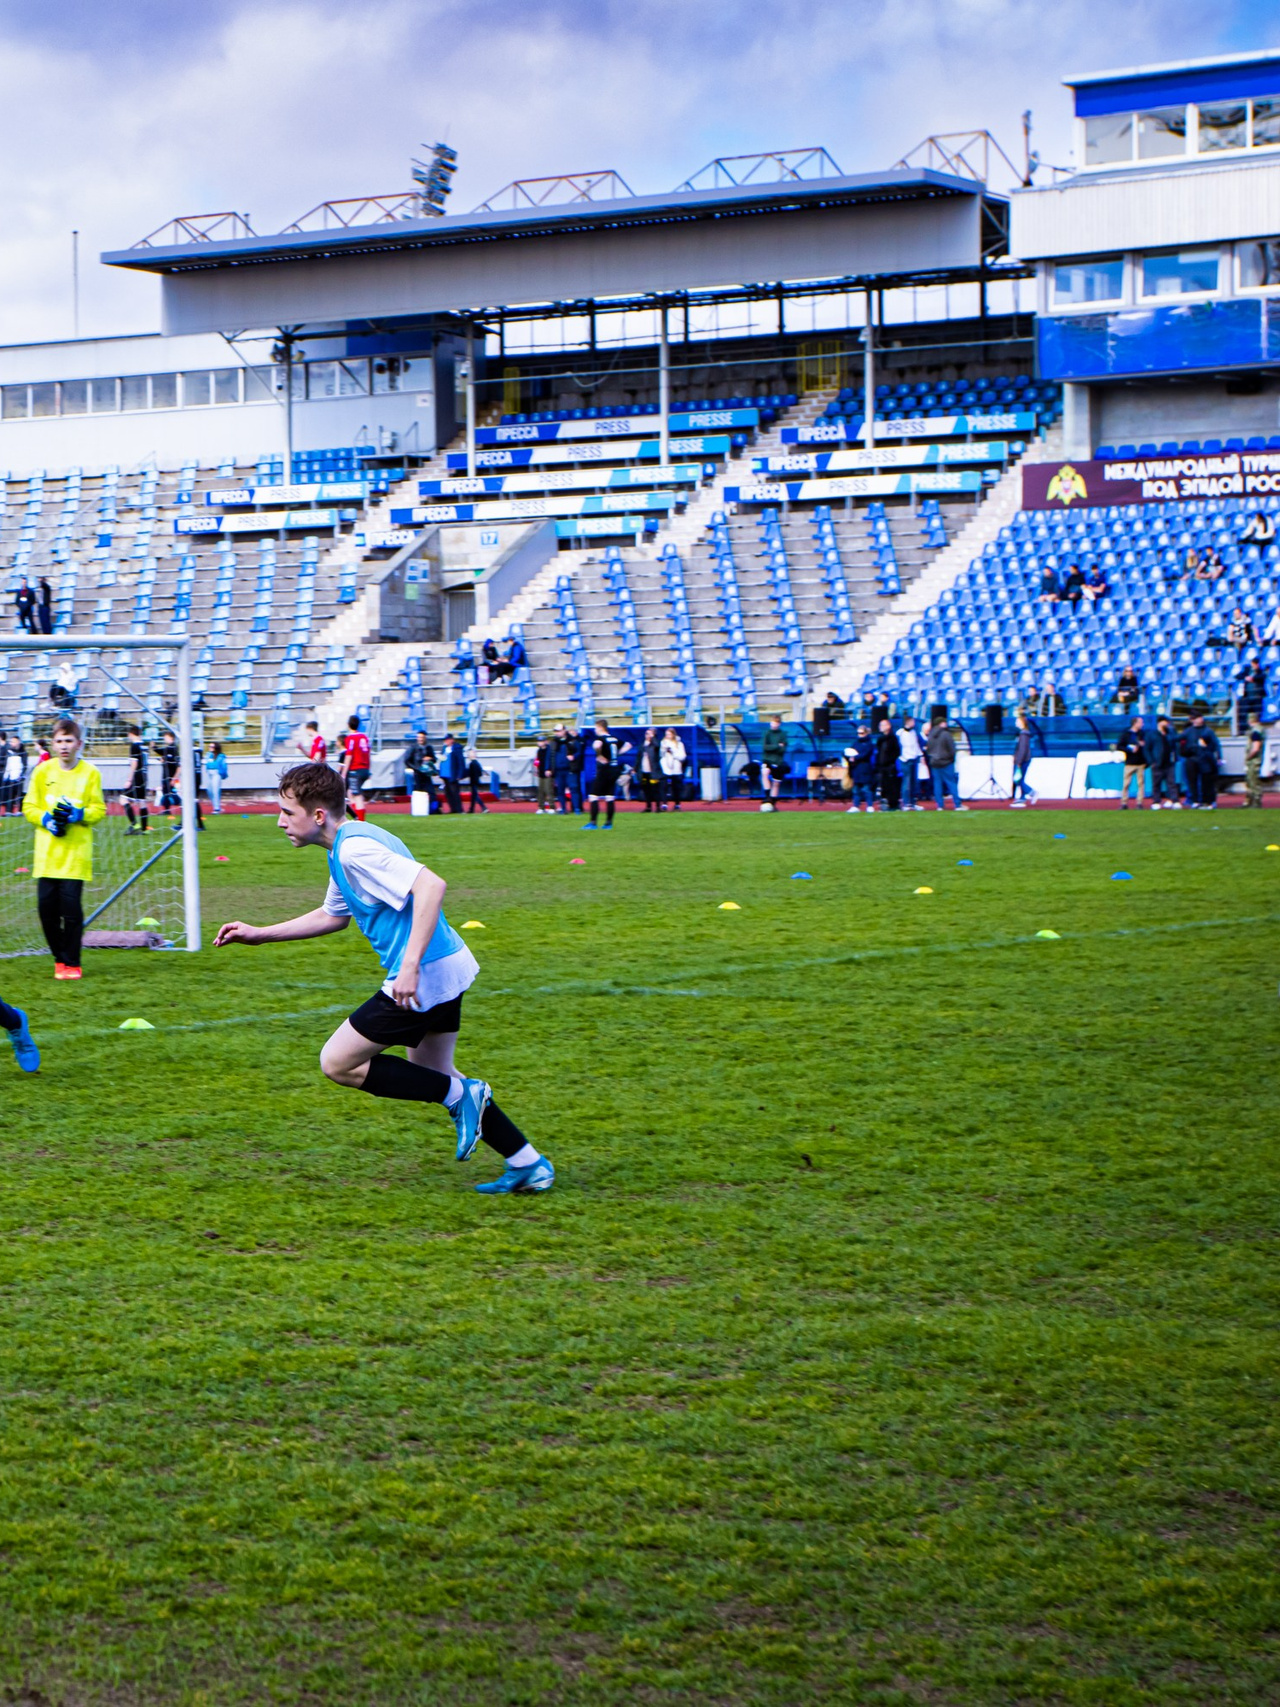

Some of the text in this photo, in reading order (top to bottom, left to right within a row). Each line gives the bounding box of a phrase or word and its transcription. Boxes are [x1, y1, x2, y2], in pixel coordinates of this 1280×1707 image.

[496, 412, 733, 440] ПРЕССА PRESS PRESSE
[798, 413, 1017, 441] ПРЕССА PRESS PRESSE
[475, 439, 704, 466] РЕССА PRESS RESSE
[768, 443, 989, 471] ПРЕССА PRESS PRESSE
[440, 466, 675, 494] ПРЕССА PRESS PRESSE
[1104, 453, 1240, 481] МЕЖДУНАРОДНЫЙ
[210, 489, 251, 503] ПРЕССА
[322, 483, 363, 498] PRESSE
[829, 477, 868, 493] PRESS
[911, 472, 962, 489] PRESSE
[1142, 480, 1179, 499] ПОД
[1180, 473, 1244, 497] ЭГИДОЙ
[412, 506, 457, 521] ПРЕССА
[602, 494, 649, 509] PRESSE
[177, 517, 218, 532] ПРЕССА
[481, 533, 498, 544] 17
